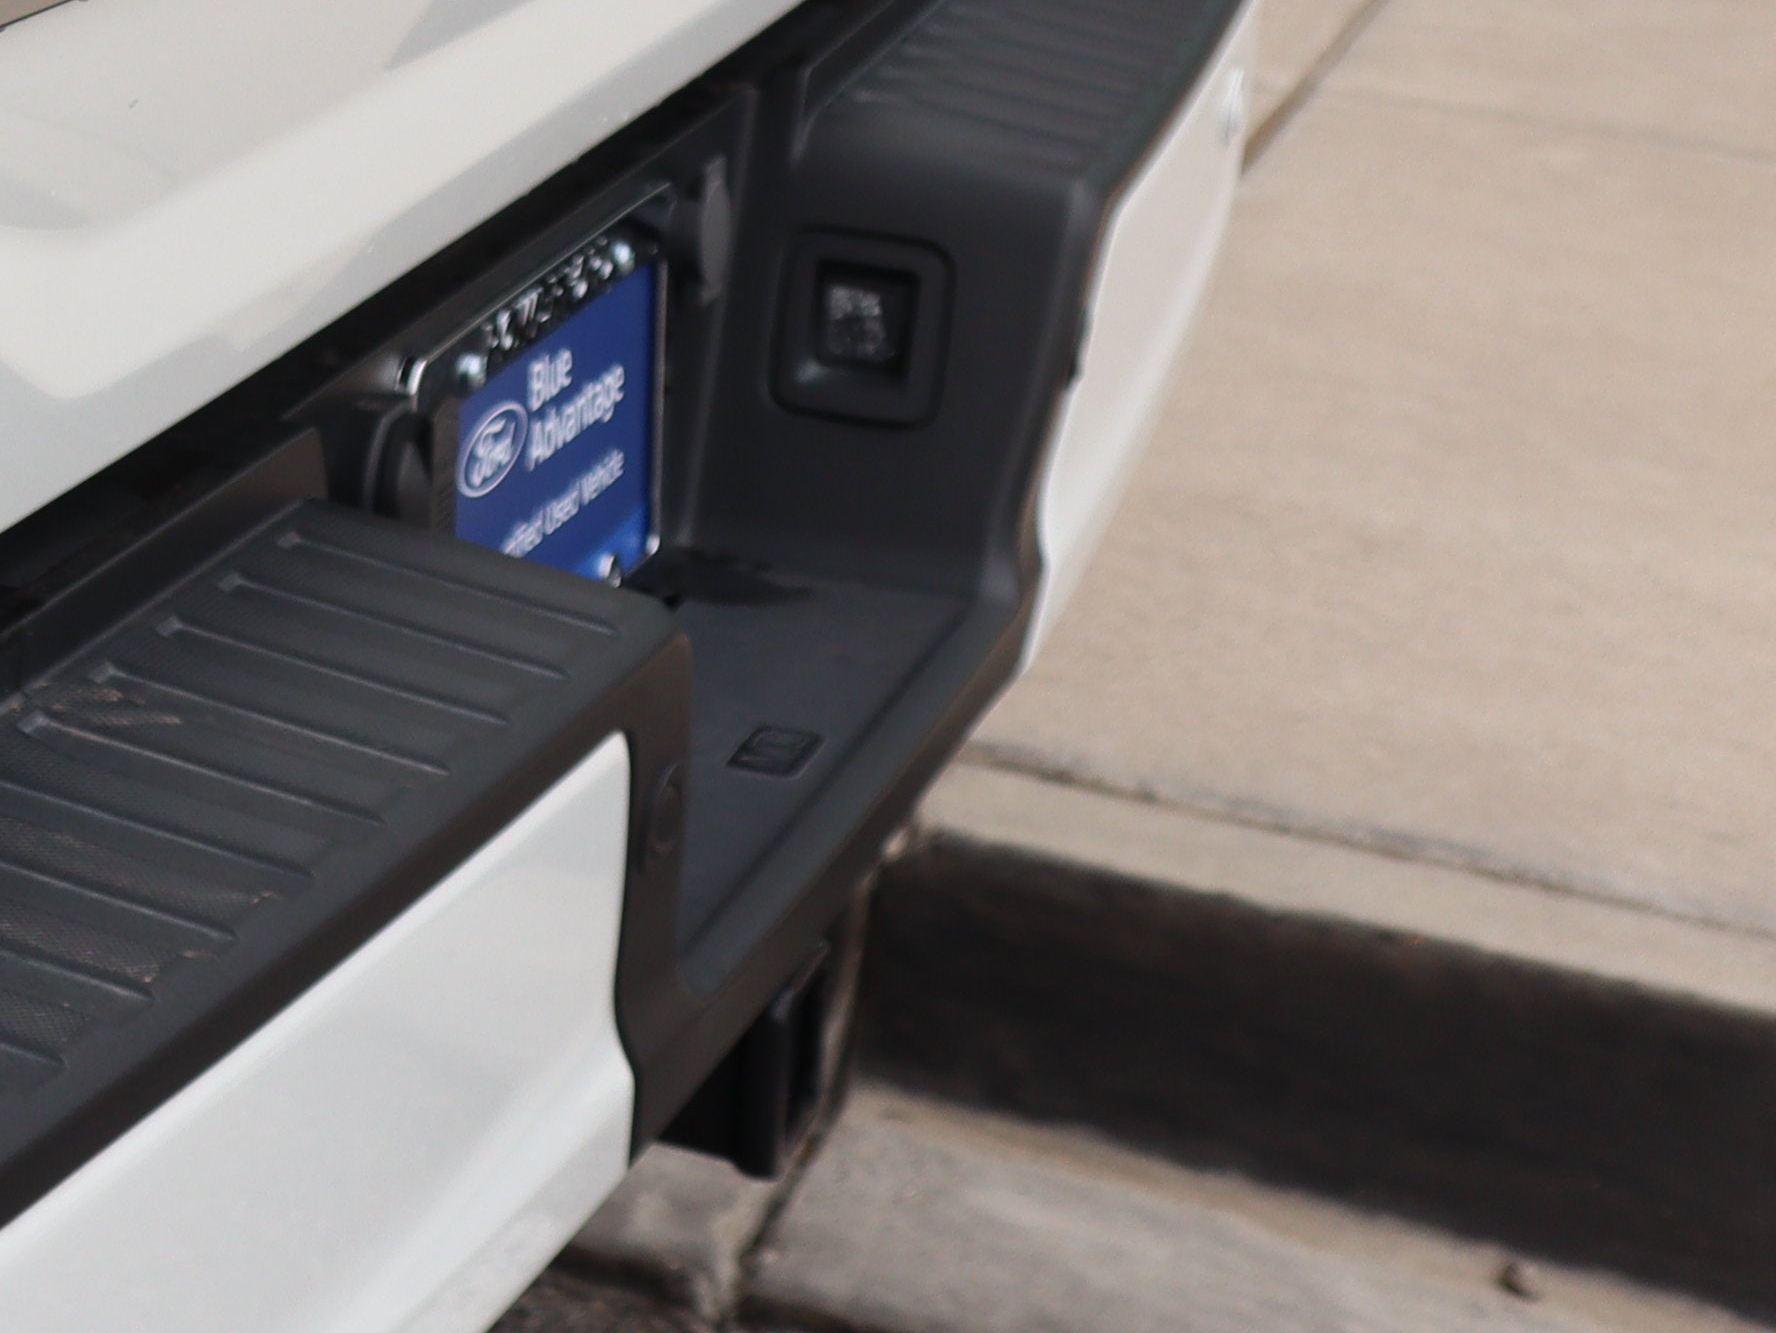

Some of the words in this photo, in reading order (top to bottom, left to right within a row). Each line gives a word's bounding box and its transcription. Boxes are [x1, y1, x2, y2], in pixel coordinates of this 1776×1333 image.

[525, 364, 625, 472] Advantage
[528, 347, 573, 412] Blue
[545, 479, 581, 536] Used
[580, 448, 625, 507] Vehicle
